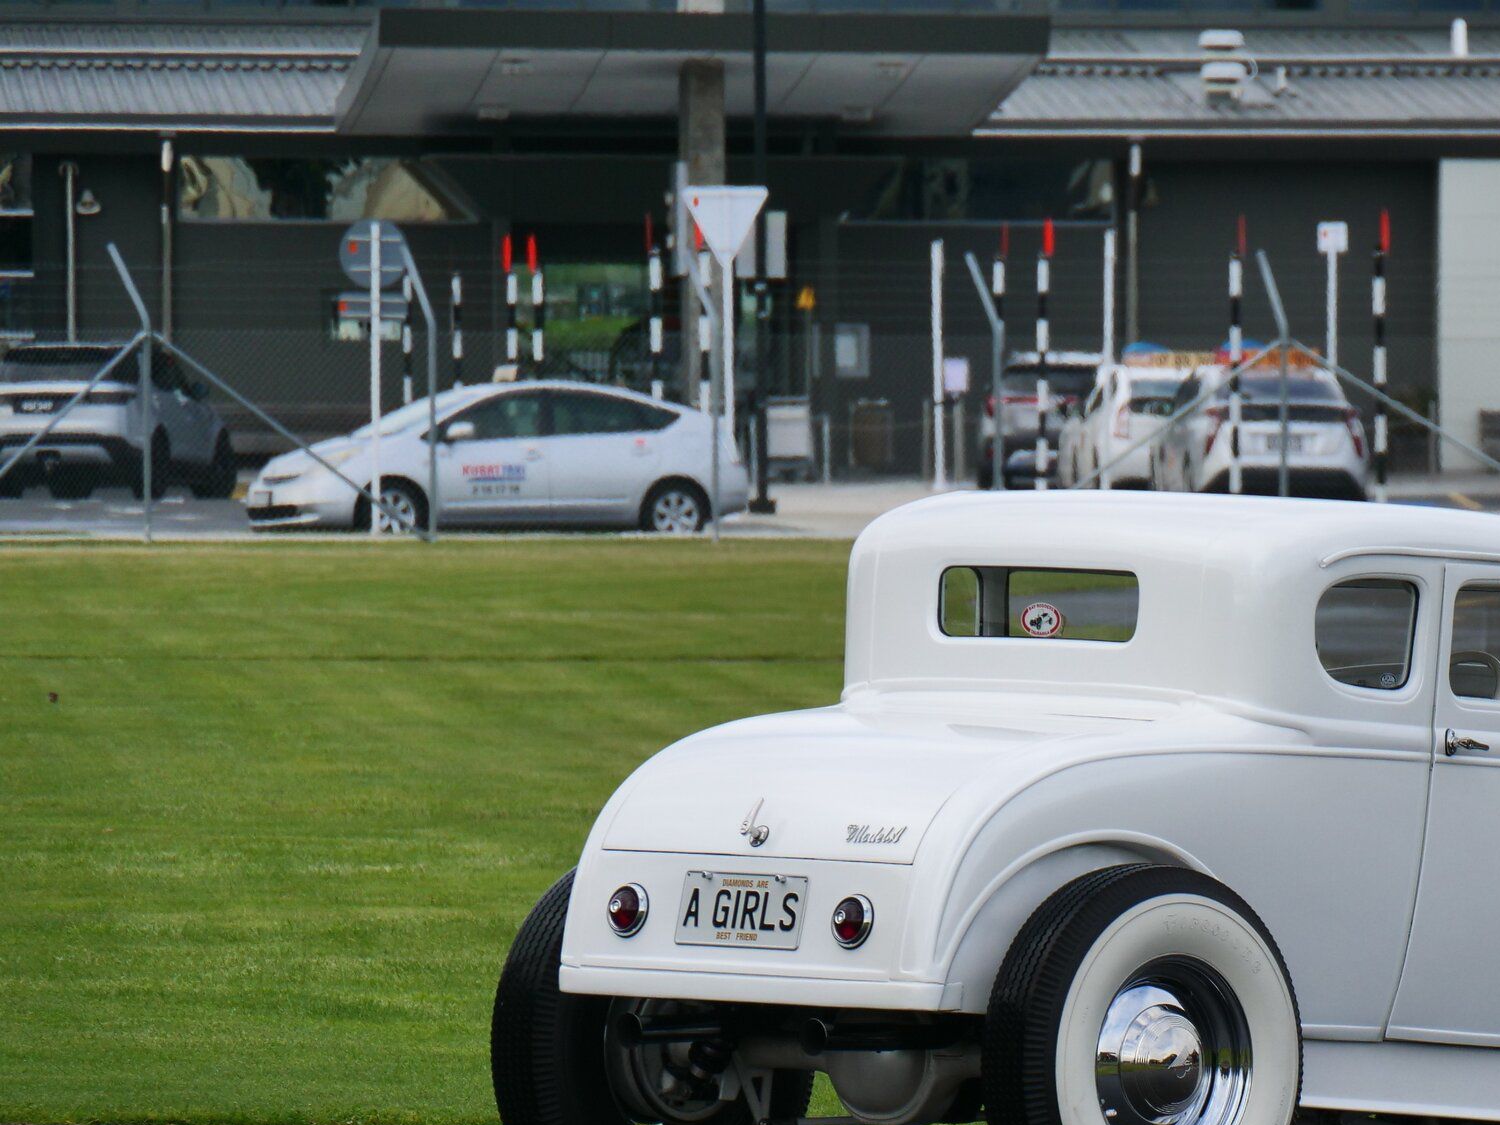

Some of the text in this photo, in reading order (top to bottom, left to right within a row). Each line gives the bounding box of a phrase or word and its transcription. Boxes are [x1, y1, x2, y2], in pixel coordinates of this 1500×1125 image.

[722, 878, 769, 889] DIAMONDS ARE
[683, 888, 799, 932] A GIRLS
[716, 931, 758, 941] BEST FRIEND
